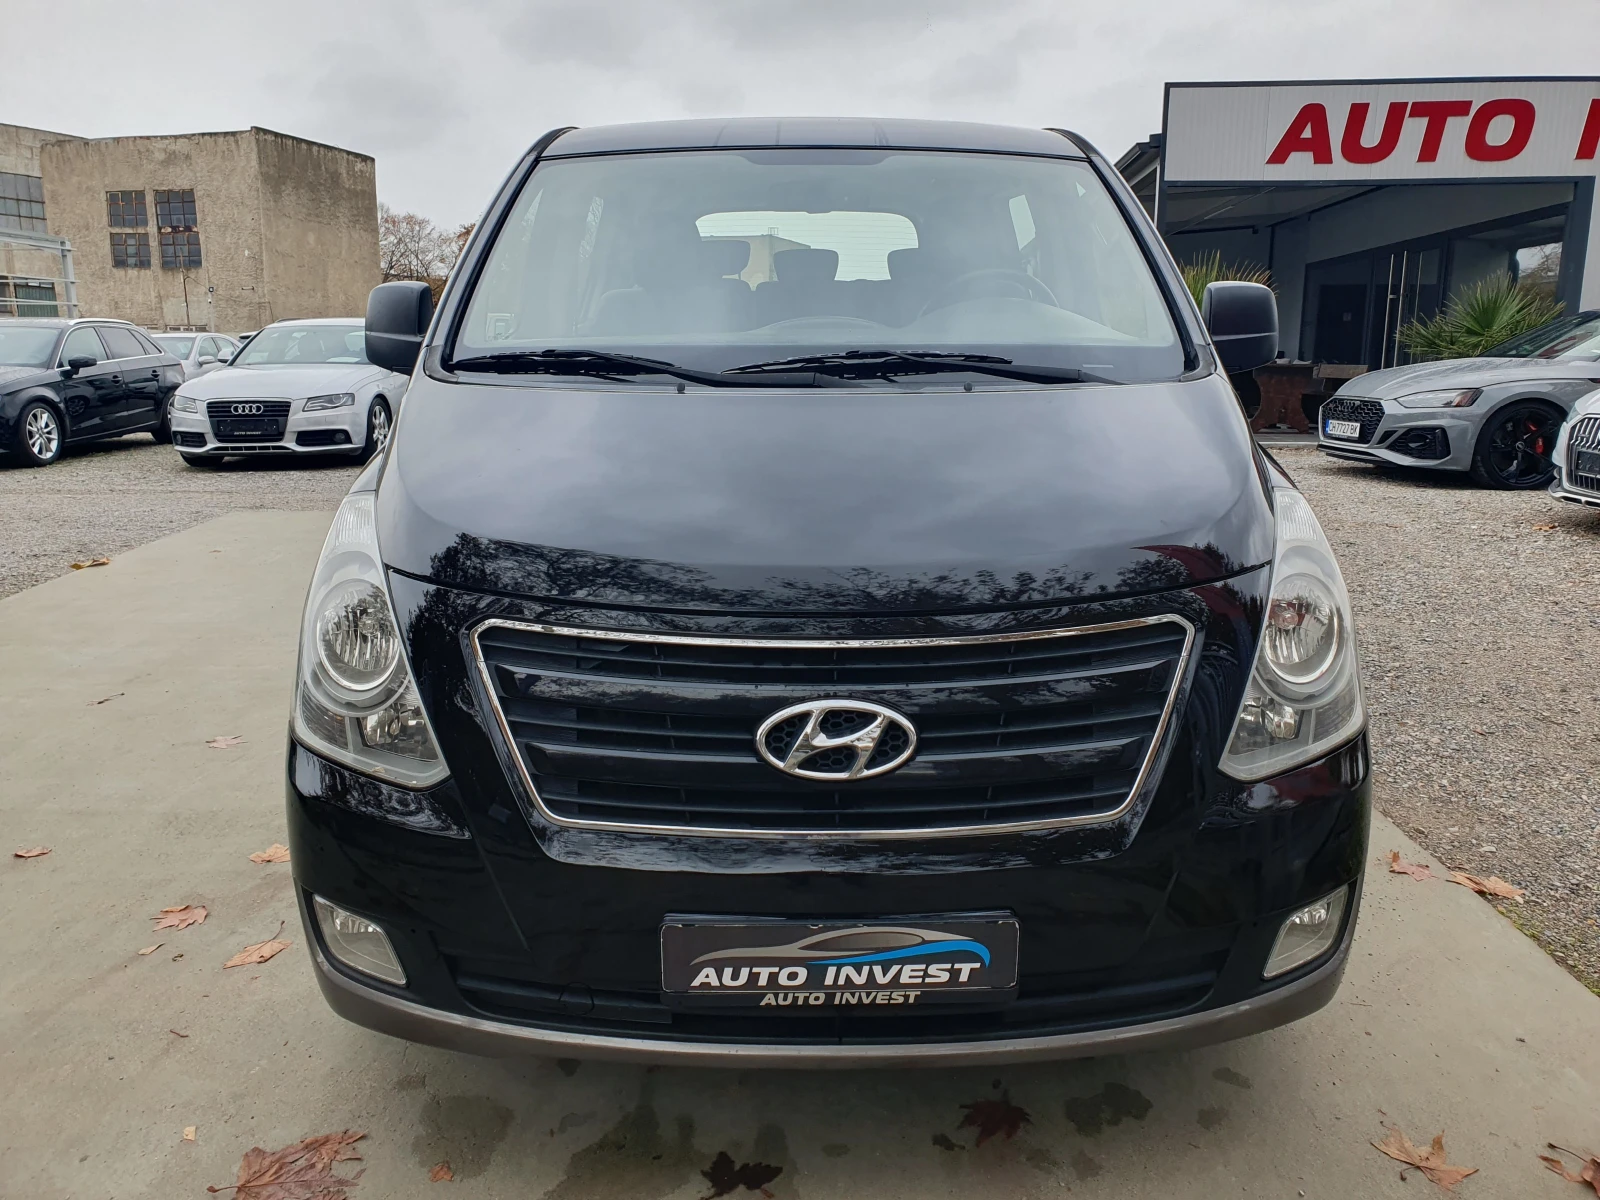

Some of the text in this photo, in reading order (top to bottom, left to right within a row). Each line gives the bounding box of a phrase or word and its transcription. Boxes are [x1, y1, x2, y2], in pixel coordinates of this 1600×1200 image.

[1265, 98, 1536, 165] AUTO
[689, 962, 981, 987] AUTO INVEST
[759, 990, 921, 1006] AUTO INVEST
